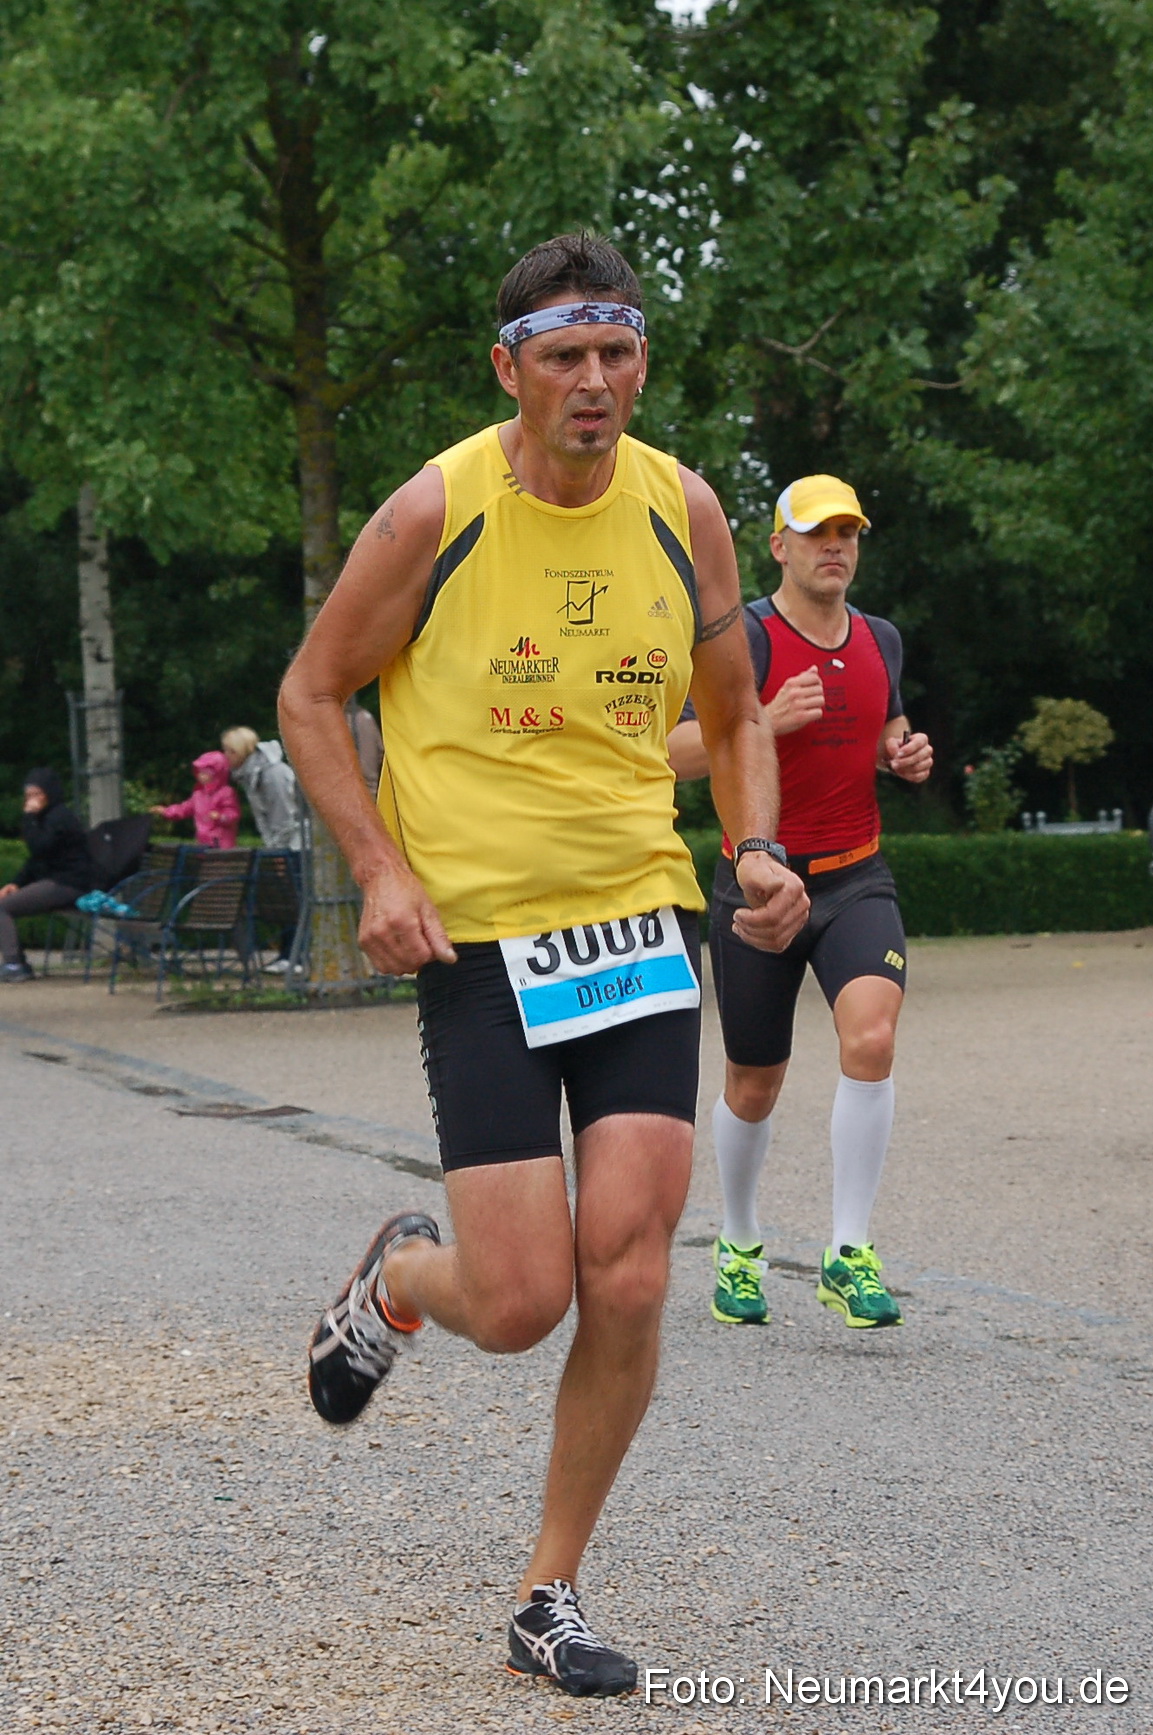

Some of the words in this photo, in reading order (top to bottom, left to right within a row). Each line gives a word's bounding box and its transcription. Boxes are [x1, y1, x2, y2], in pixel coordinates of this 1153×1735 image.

[559, 627, 611, 637] NEUMARKT
[489, 657, 561, 675] NEUMARKTER
[490, 707, 511, 727] M
[519, 706, 541, 727] &
[549, 706, 564, 727] S
[576, 974, 643, 1009] Dieter
